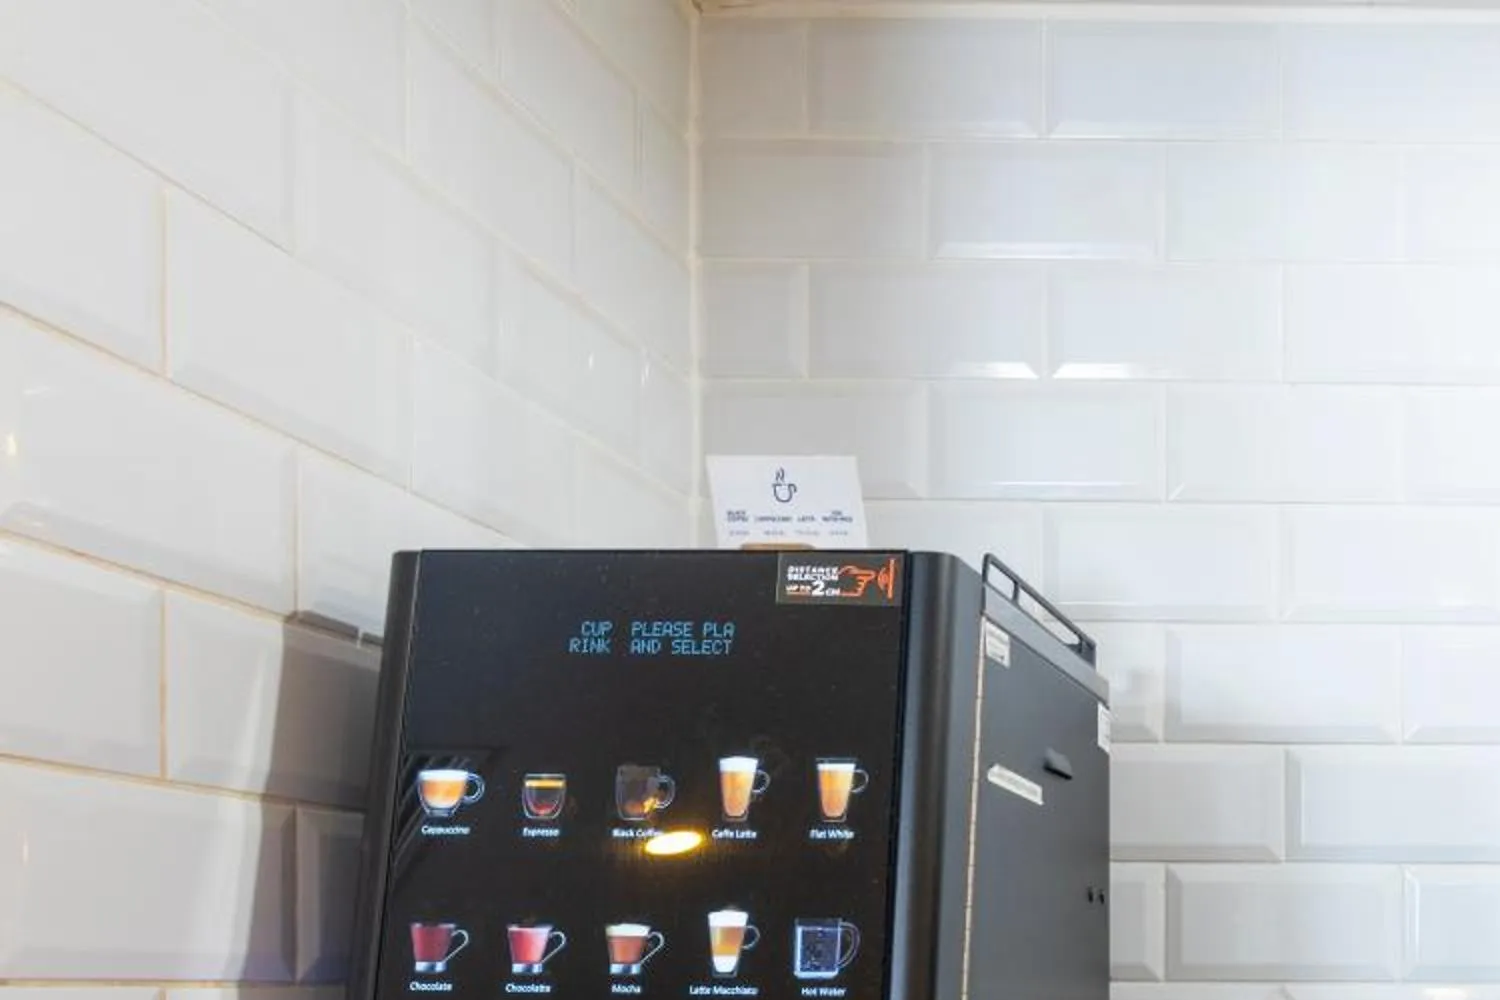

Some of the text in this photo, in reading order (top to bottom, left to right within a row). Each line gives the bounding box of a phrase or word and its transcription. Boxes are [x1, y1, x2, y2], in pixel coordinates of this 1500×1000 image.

[811, 580, 825, 597] 2
[581, 621, 735, 637] CUP PLEASE PLA
[569, 637, 733, 655] RINK AND SELECT
[421, 825, 471, 836] Cappuccino
[522, 827, 560, 838] Espresso
[612, 828, 634, 837] Black
[735, 829, 757, 838] Latte
[809, 829, 855, 839] Flat White
[409, 981, 453, 991] Chocolate
[611, 983, 641, 993] Mocha
[689, 984, 759, 995] Latte Macchiato
[801, 987, 847, 997] Hot Water
